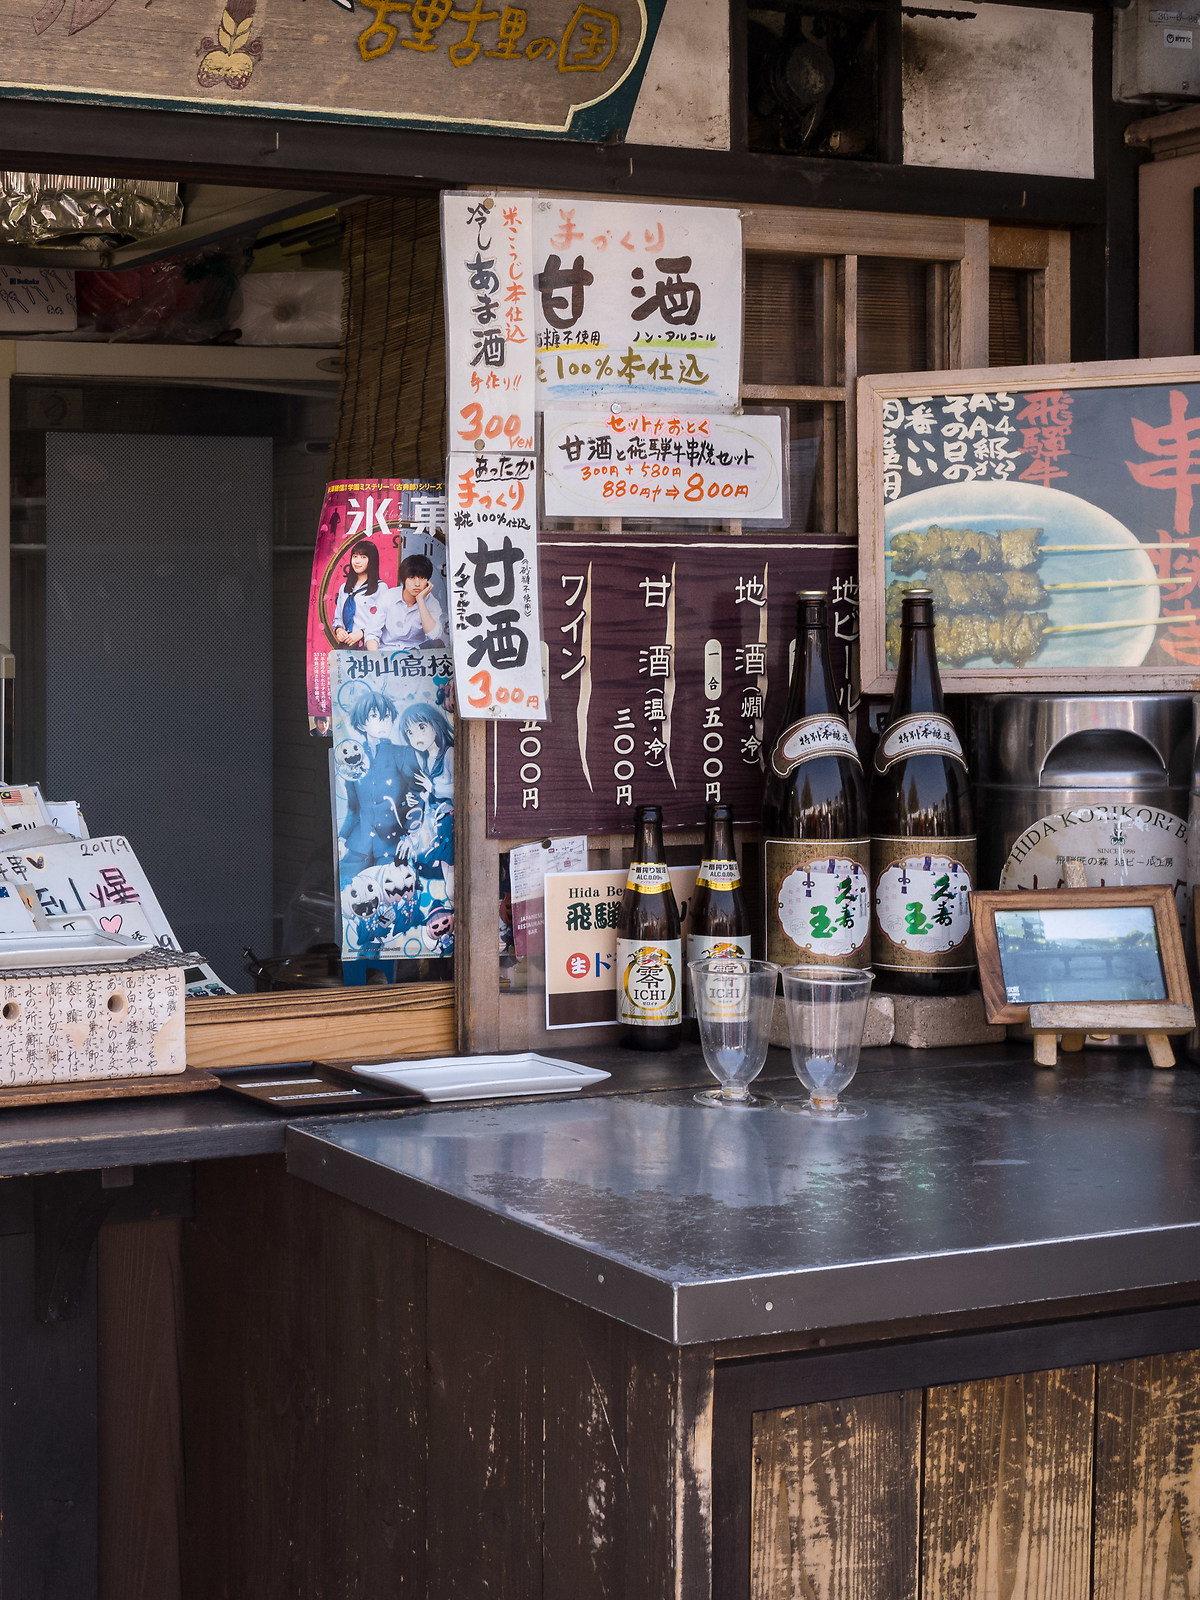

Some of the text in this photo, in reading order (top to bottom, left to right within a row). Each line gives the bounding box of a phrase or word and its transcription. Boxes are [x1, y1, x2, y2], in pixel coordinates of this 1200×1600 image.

[550, 208, 664, 252] 手づくり
[466, 203, 506, 367] 冷しあま酒
[534, 254, 701, 330] 甘酒
[458, 402, 521, 441] 300
[1015, 389, 1075, 488] 飛騨牛
[458, 467, 525, 511] 手づくり
[581, 464, 681, 480] 300円 580円
[684, 473, 748, 502] 800円
[345, 495, 448, 538] 氷菓
[464, 535, 529, 671] 甘酒
[560, 574, 587, 682] ワイン
[346, 652, 453, 680] 神山高校
[467, 669, 540, 710] 300円
[1011, 821, 1057, 864] HIDA
[569, 885, 626, 899] Hida Be
[634, 989, 666, 1001] ICHI
[636, 966, 664, 990] 零
